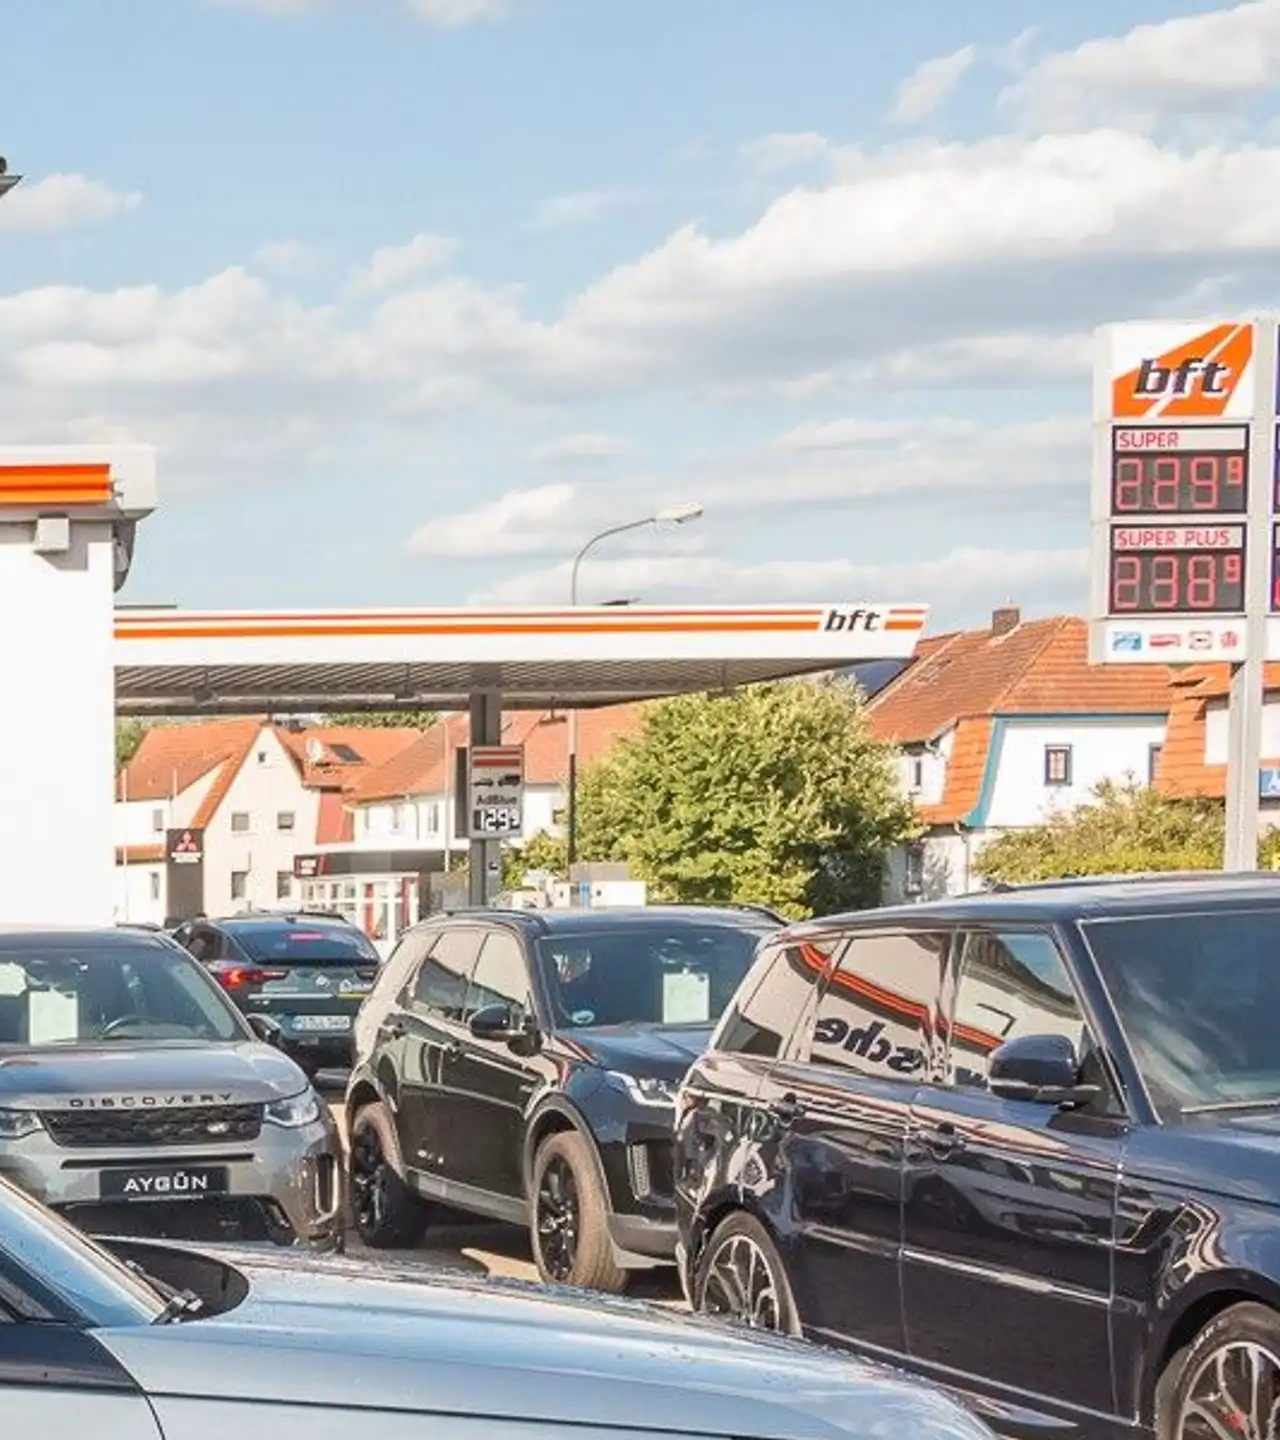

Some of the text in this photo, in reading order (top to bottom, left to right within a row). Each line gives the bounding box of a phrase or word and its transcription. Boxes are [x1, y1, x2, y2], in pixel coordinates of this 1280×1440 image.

[1133, 357, 1228, 396] bft
[1118, 432, 1180, 449] SUPER
[1117, 529, 1231, 548] SUPER PLUS
[824, 609, 881, 632] bft
[69, 1092, 232, 1108] DISCOVERY
[122, 1171, 208, 1192] AYGÜN
